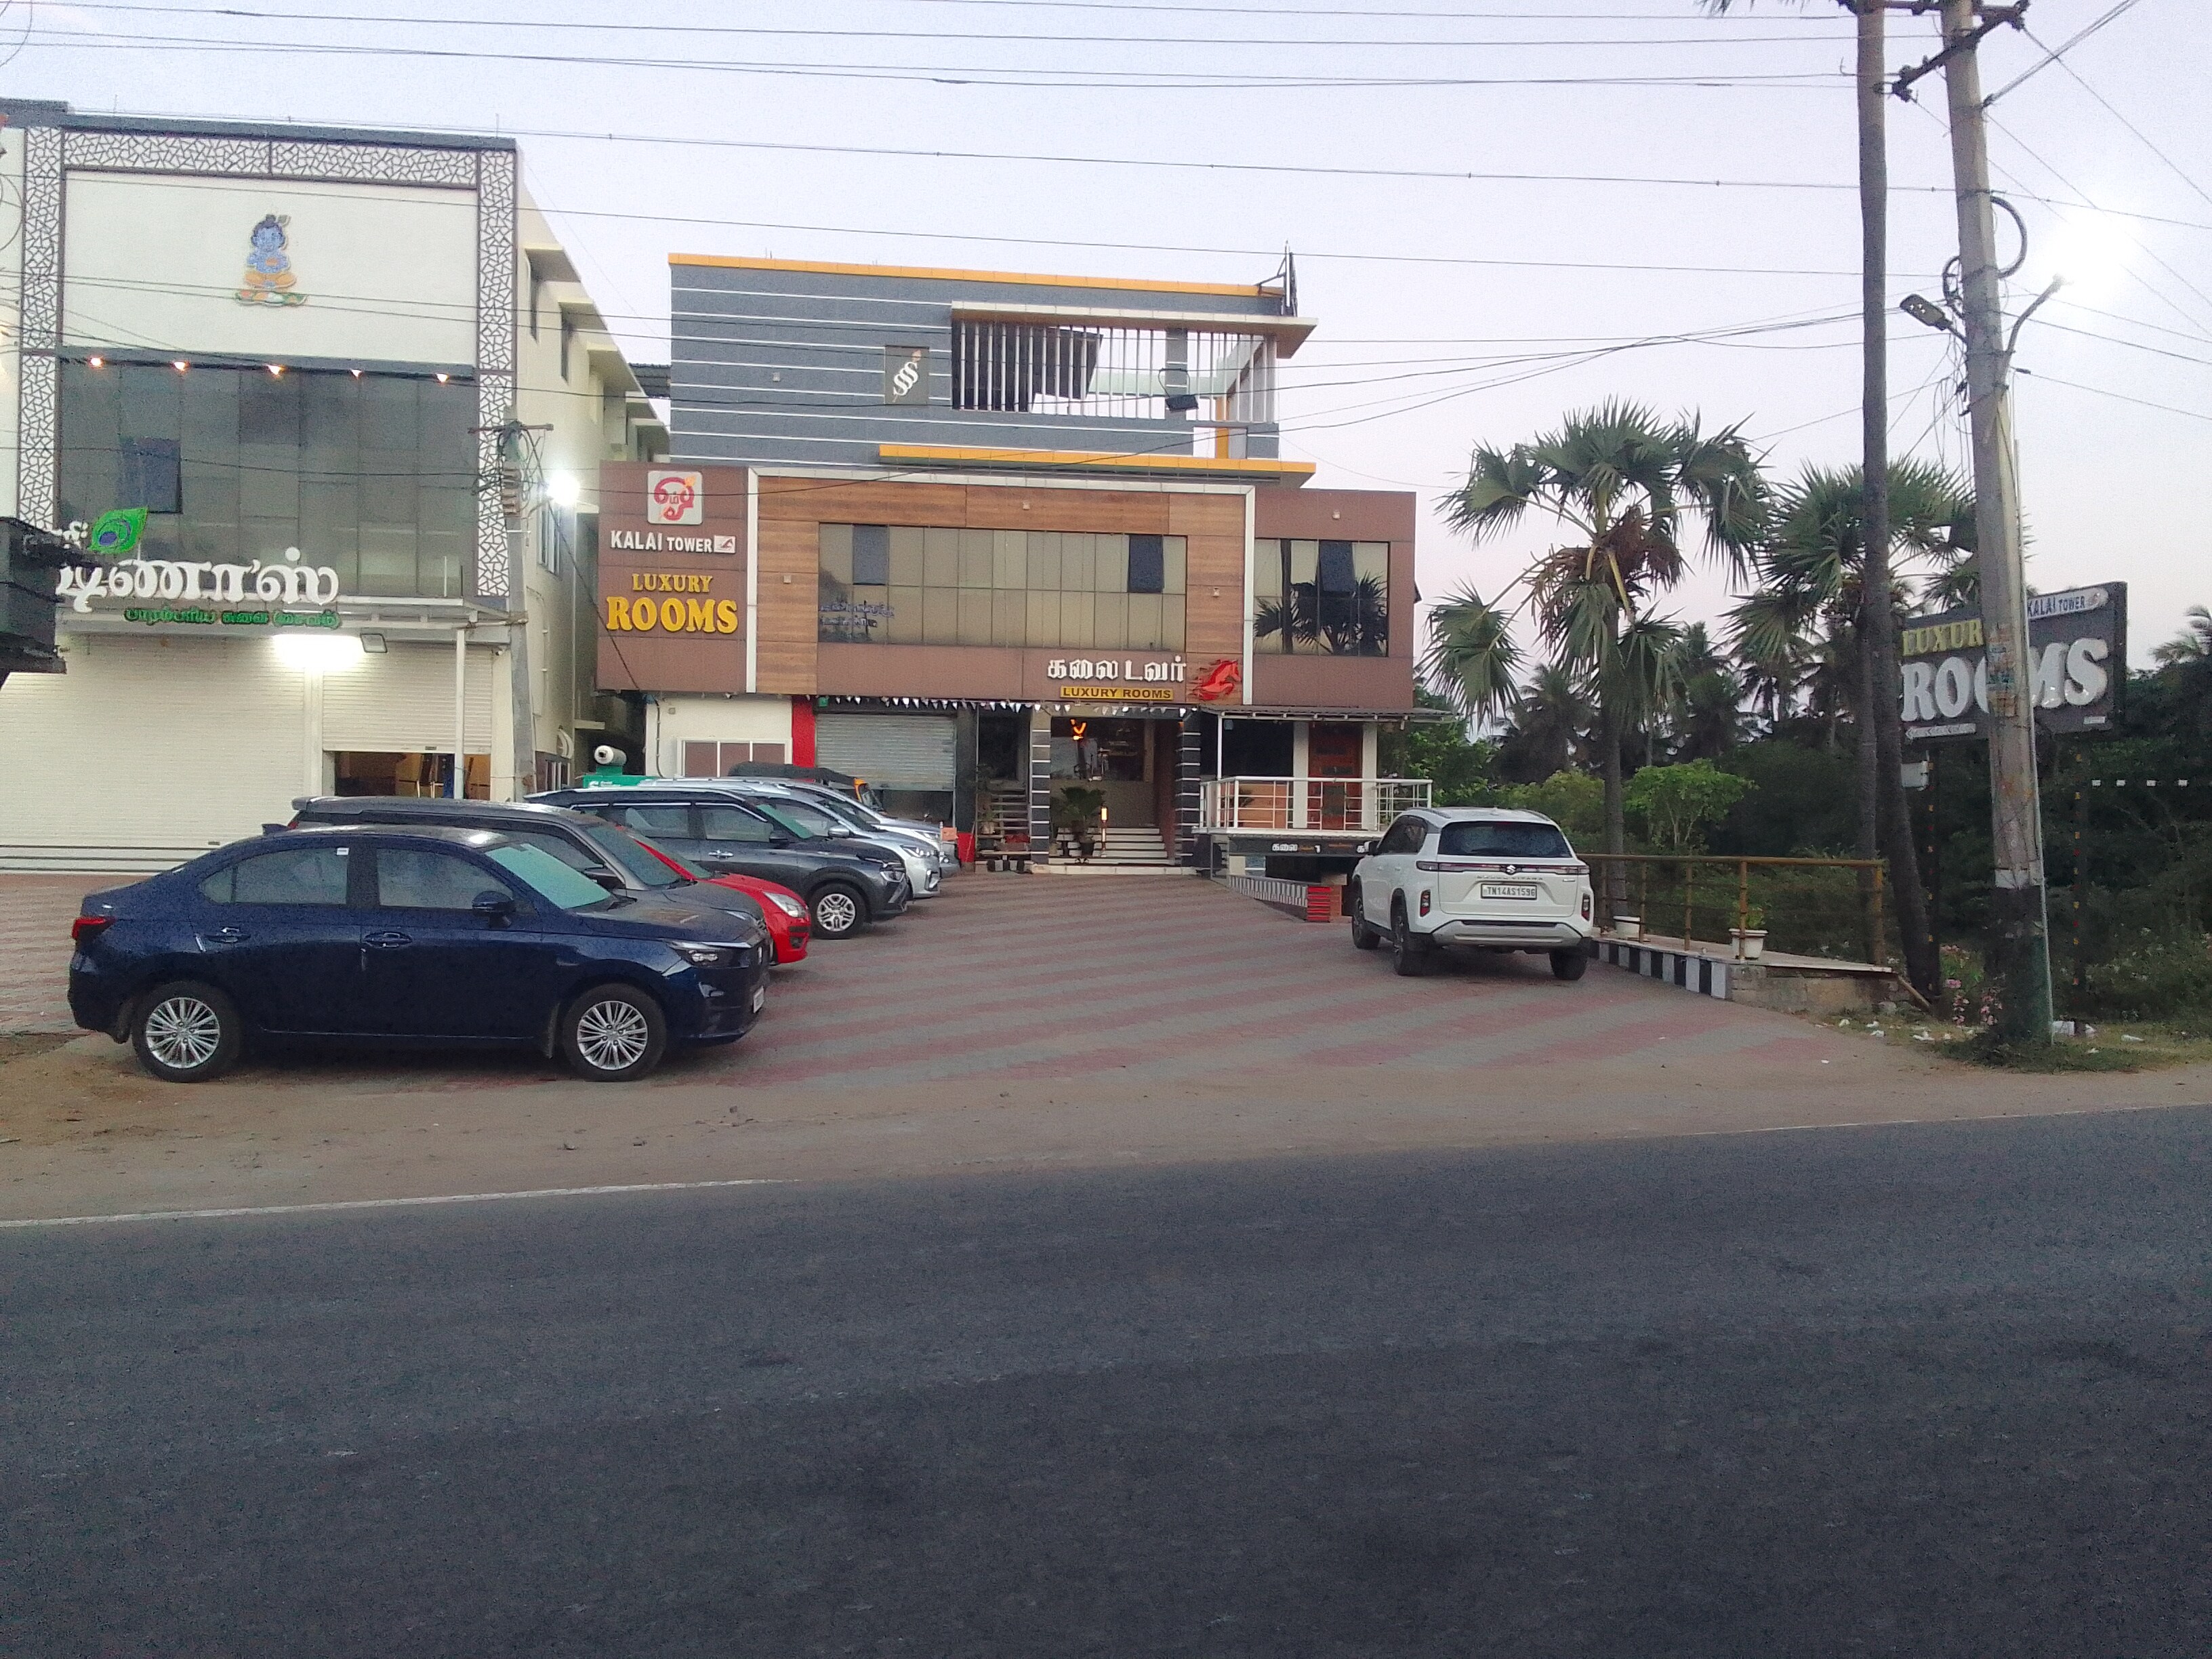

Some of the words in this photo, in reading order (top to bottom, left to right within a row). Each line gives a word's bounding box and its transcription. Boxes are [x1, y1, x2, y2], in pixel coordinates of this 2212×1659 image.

[610, 531, 662, 551] KALAI
[667, 537, 712, 552] TOWER
[632, 573, 713, 593] LUXURY
[606, 596, 738, 634] ROOMS
[2027, 598, 2056, 619] KALAI
[2060, 595, 2085, 611] TOWER
[1902, 619, 1984, 656] LUXUR
[1048, 657, 1118, 680] கலை
[1124, 655, 1187, 682] டவர்
[1063, 687, 1118, 697] LUXURY
[1123, 689, 1171, 699] ROOMS
